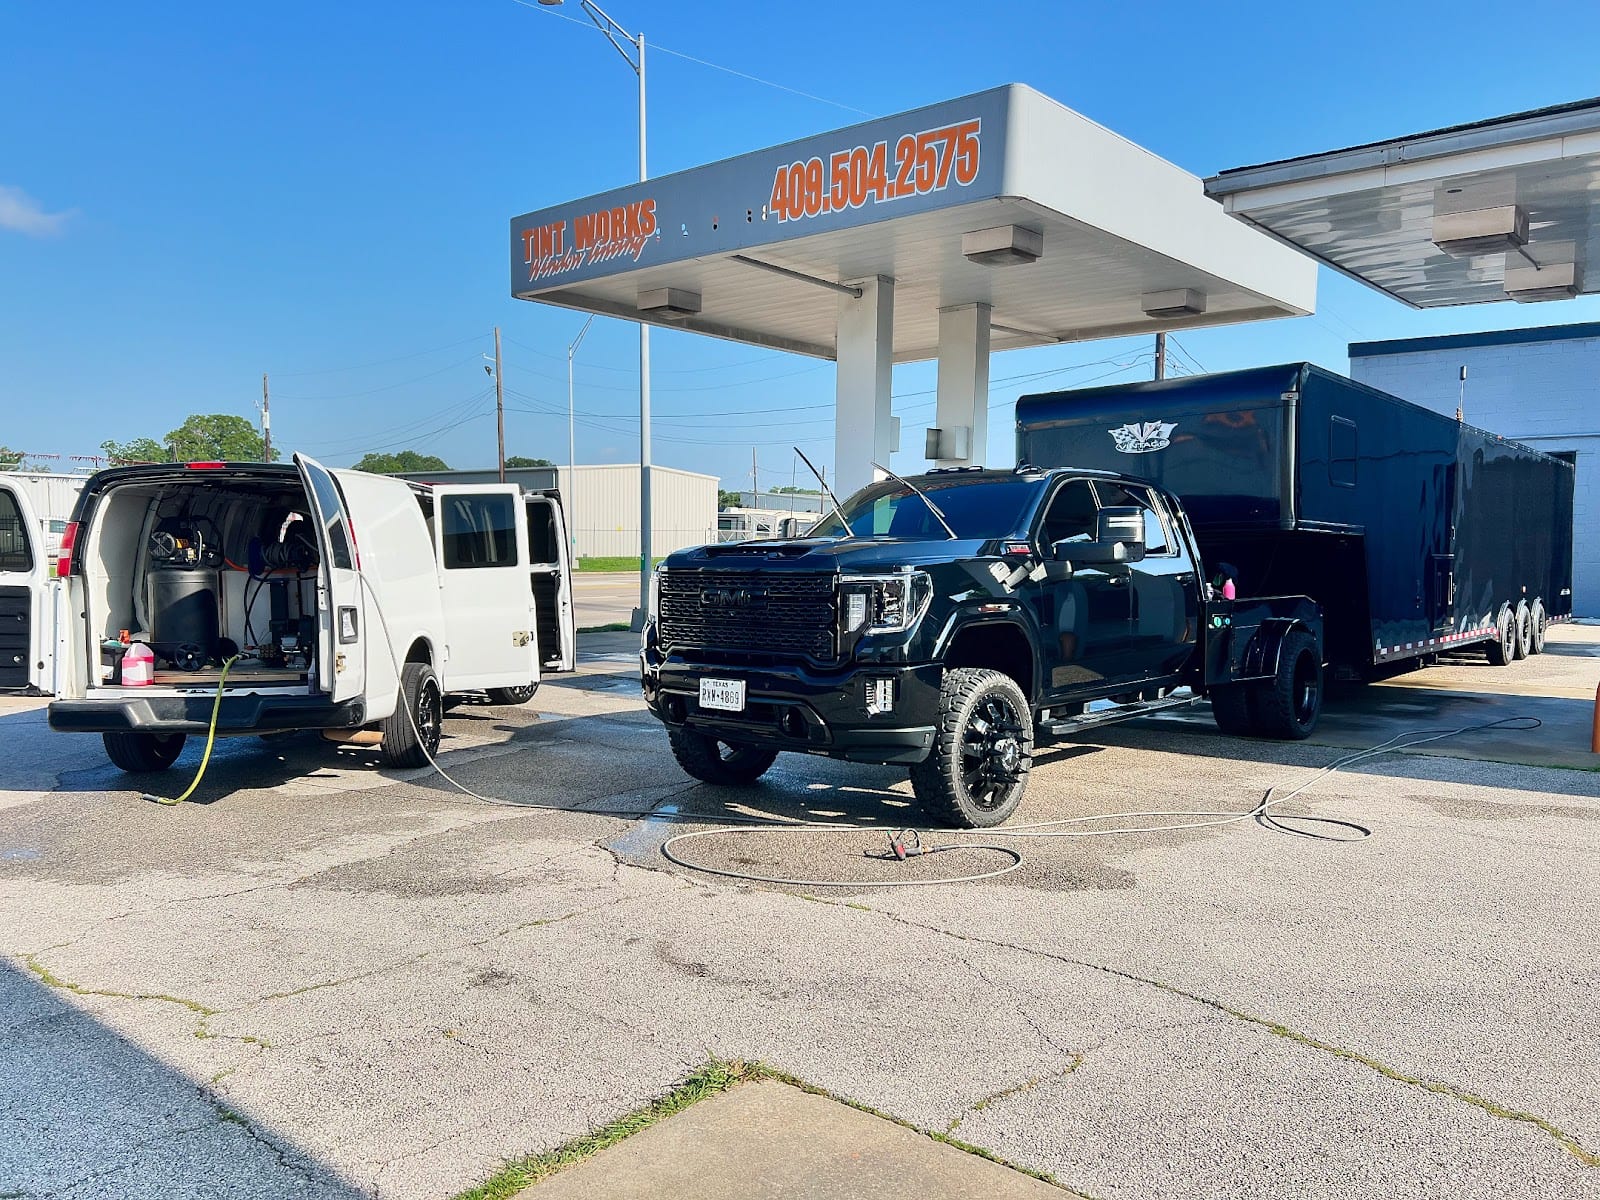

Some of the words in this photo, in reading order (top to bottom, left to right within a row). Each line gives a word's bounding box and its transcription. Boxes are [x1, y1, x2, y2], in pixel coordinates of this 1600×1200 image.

[770, 117, 981, 223] 409.504.2575
[521, 220, 567, 264] TINT
[574, 199, 656, 252] WORKS
[529, 247, 585, 282] Window
